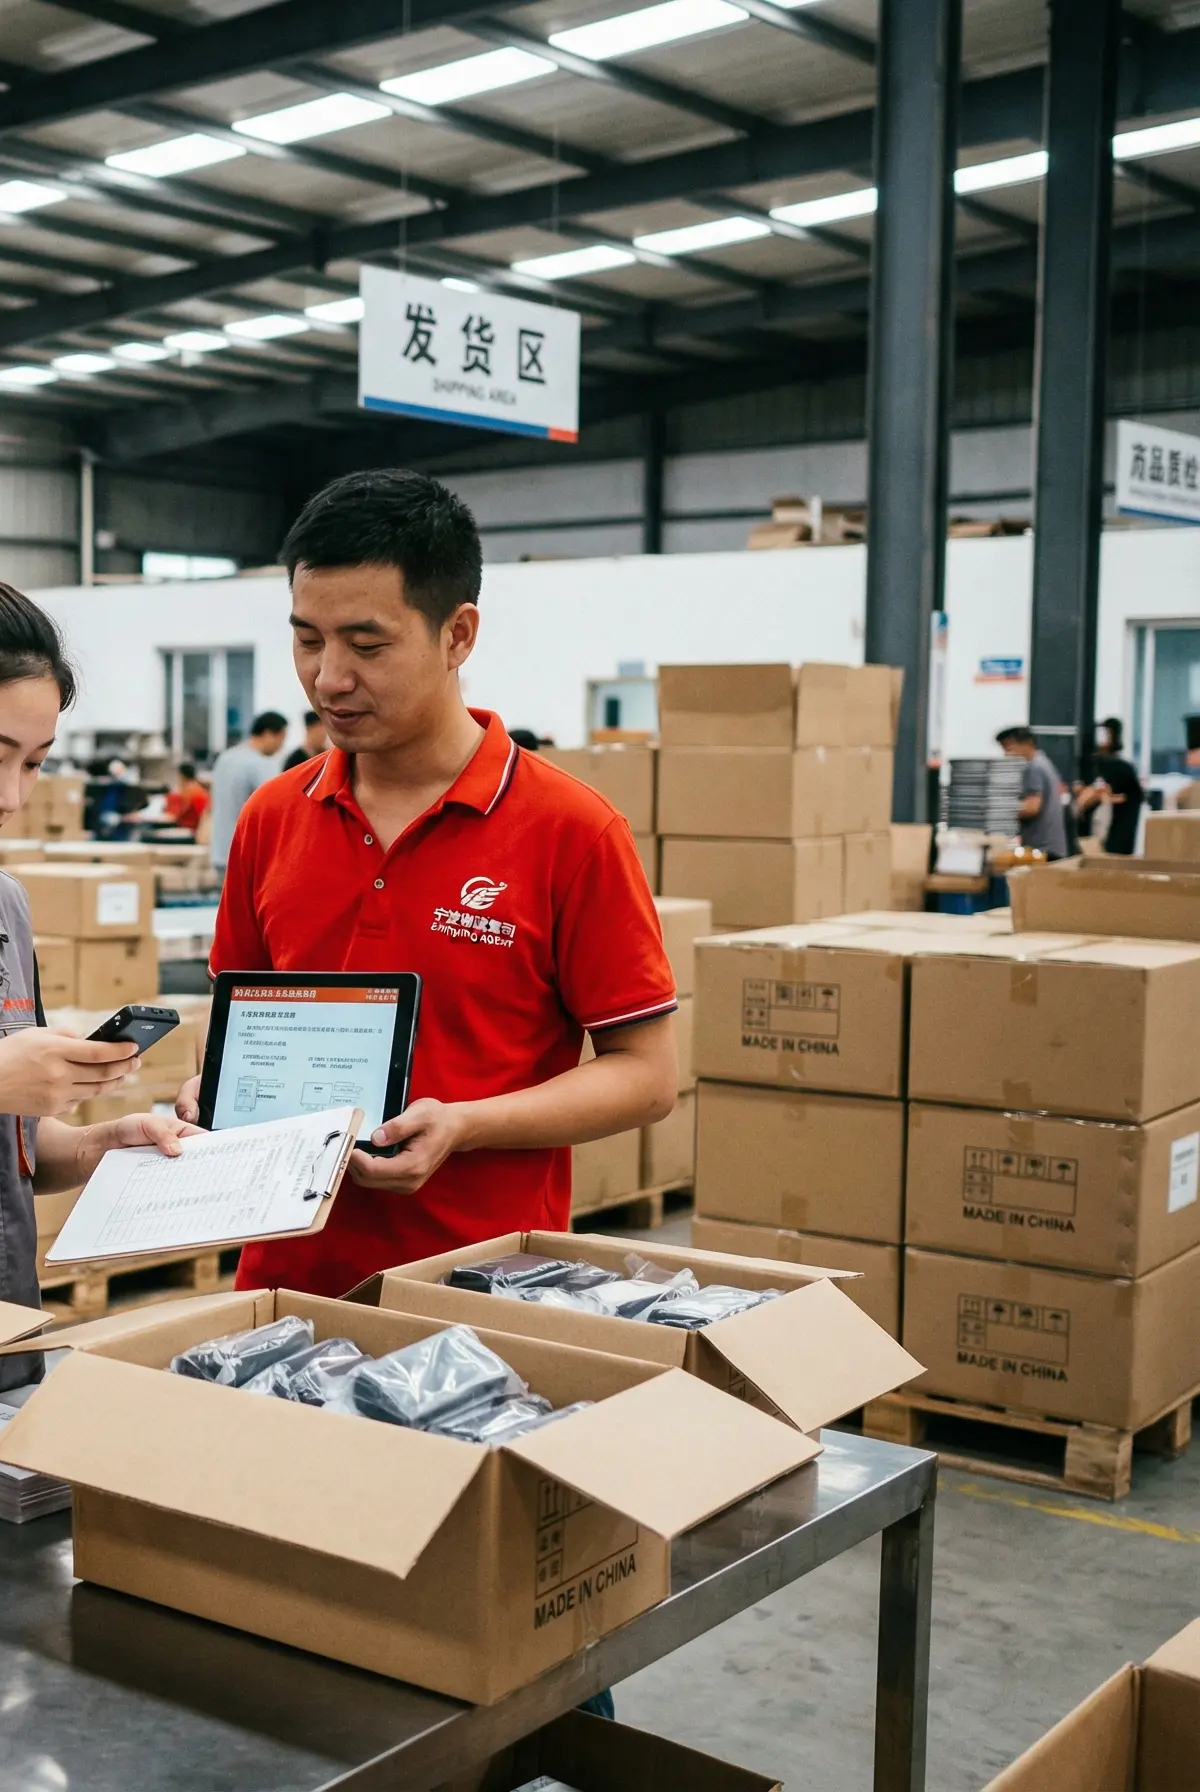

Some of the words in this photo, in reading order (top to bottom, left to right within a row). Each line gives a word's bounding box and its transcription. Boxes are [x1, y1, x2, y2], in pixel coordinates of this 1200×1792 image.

[402, 302, 547, 384] 发货区
[742, 1034, 778, 1050] MADE
[782, 1038, 794, 1052] IN
[798, 1040, 839, 1055] CHINA
[962, 1206, 1004, 1224] MADE
[1009, 1213, 1024, 1227] IN
[1027, 1215, 1075, 1233] CHINA
[956, 1351, 998, 1370] MADE
[1002, 1359, 1017, 1374] IN
[1021, 1363, 1068, 1383] CHINA
[534, 1586, 575, 1630] MADE
[579, 1576, 592, 1603] IN
[595, 1553, 636, 1593] CHINA
